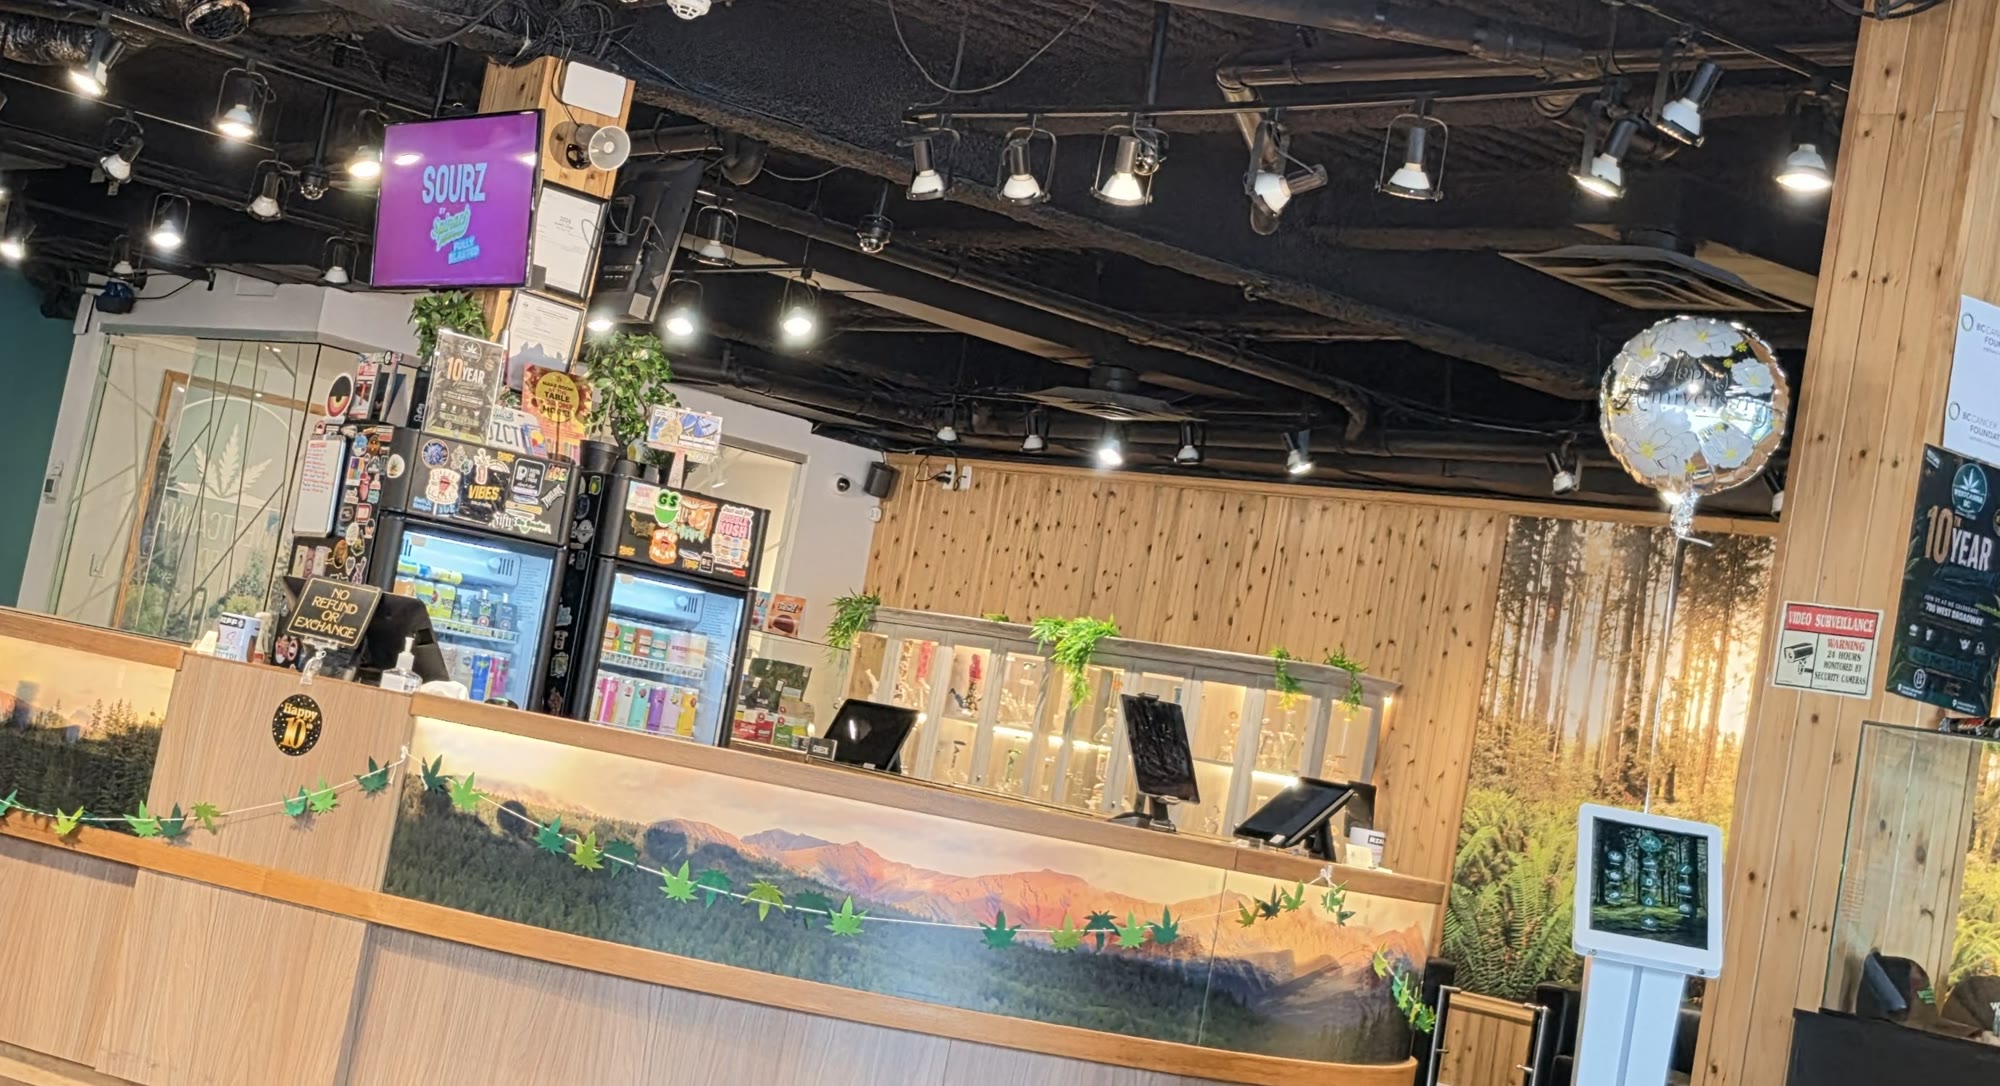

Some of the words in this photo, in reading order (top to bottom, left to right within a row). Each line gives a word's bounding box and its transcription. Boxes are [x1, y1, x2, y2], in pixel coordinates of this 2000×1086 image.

[422, 163, 487, 204] SOURZ
[461, 367, 485, 385] YEAR
[544, 391, 570, 402] TABLE
[468, 484, 500, 501] VIBES
[659, 492, 678, 508] GS
[719, 513, 750, 526] BUBBLE
[718, 521, 748, 538] KUSH
[1950, 527, 1993, 571] YEAR
[331, 588, 350, 600] NO
[311, 597, 358, 615] REFUND
[321, 610, 340, 623] OR
[1788, 610, 1812, 626] VIDEO
[1815, 613, 1875, 633] SURVEILLANCE
[1936, 605, 1952, 618] WEST
[1951, 610, 1984, 626] BROADWAY
[294, 616, 357, 639] EXCHANGE
[1827, 638, 1866, 652] WARNING
[1827, 650, 1836, 658] 24
[1838, 651, 1861, 661] HOURS
[1823, 660, 1853, 672] MONITORED
[1854, 664, 1863, 673] BY
[1814, 671, 1839, 682] SECURITY
[1841, 674, 1866, 685] CAMERAS
[283, 702, 318, 720] Happy
